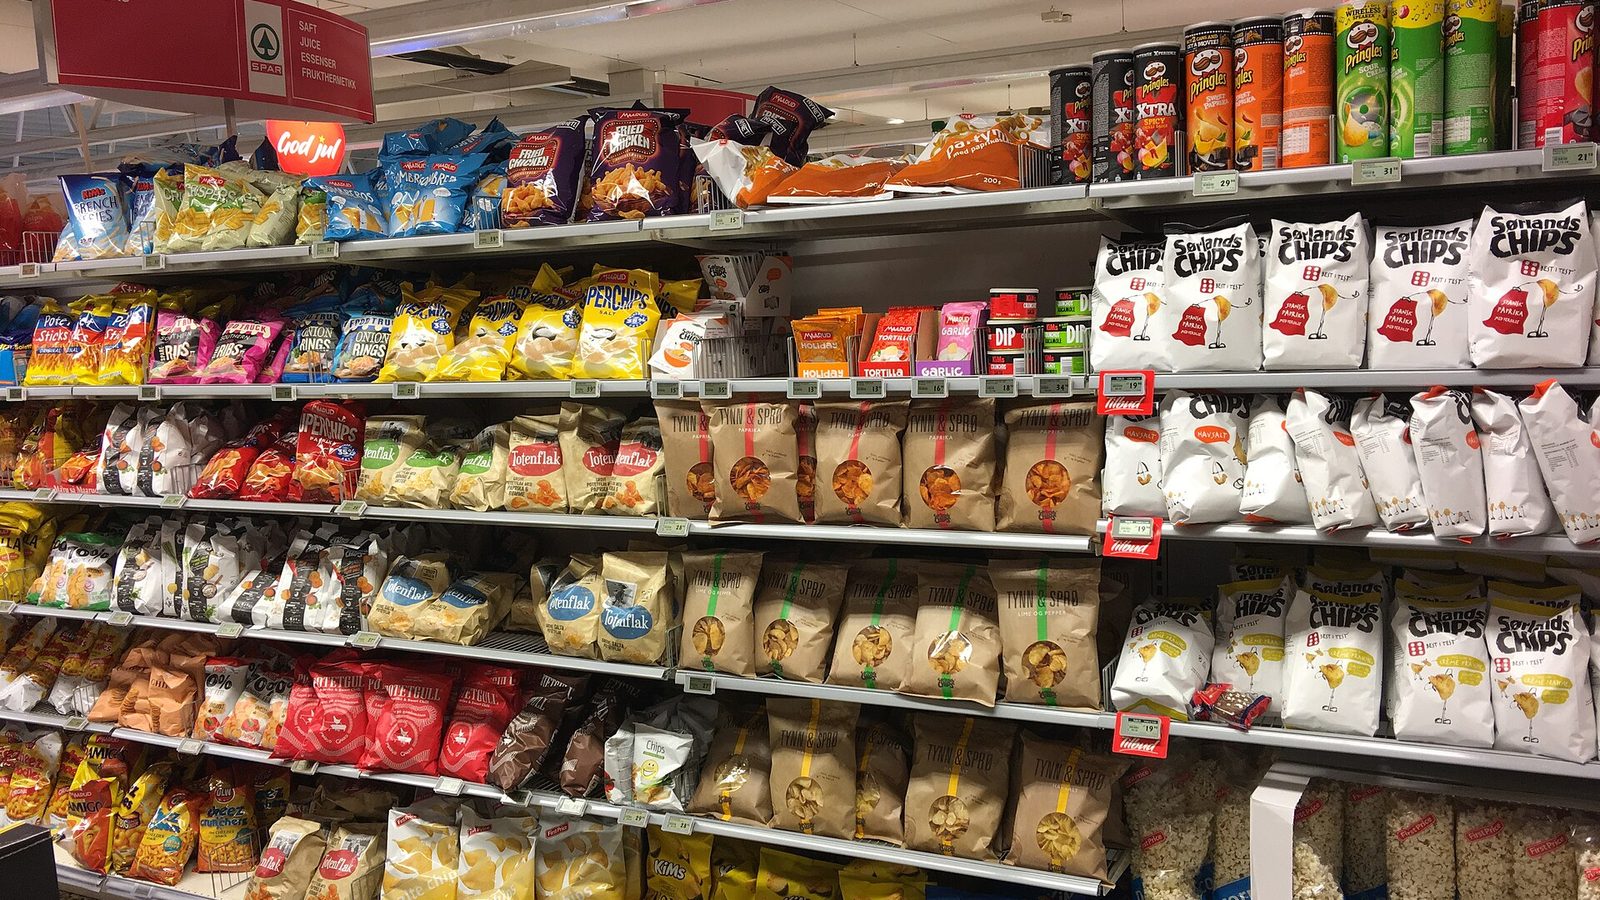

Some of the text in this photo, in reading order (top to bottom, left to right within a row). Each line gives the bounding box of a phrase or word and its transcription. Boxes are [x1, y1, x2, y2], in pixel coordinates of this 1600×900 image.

[1345, 6, 1381, 18] WIRELESS
[299, 20, 318, 35] SAFT
[299, 35, 321, 50] JUICE
[301, 52, 337, 70] ESSENSER
[1345, 44, 1383, 75] Pringles
[252, 63, 282, 75] SPAR
[1358, 63, 1380, 75] SOUR
[301, 67, 357, 91] FRUKTHERMETIKK
[1142, 77, 1169, 98] Pringles
[1190, 72, 1227, 103] Pringles
[620, 111, 650, 119] MAARUD
[1136, 103, 1177, 119] XTRA
[616, 123, 644, 136] FRIED
[277, 131, 341, 164] God jul
[518, 146, 545, 159] FRIED
[953, 147, 969, 159] med
[508, 156, 549, 170] CHICKEN
[1490, 216, 1581, 234] Sørlands
[1278, 225, 1355, 244] Sørlands
[1384, 227, 1469, 244] Sørlands
[1173, 233, 1243, 255] Sørlands
[1490, 230, 1582, 258] CHIPS
[1277, 240, 1357, 266] CHIPS
[1383, 240, 1469, 269] CHIPS
[1173, 249, 1244, 278] CHIPS
[1541, 265, 1554, 273] BEST
[1321, 270, 1334, 279] BEST
[1110, 311, 1132, 323] PAPRIKA
[1281, 309, 1306, 320] PAPRIKA
[1497, 306, 1524, 317] PAPRIKA
[239, 323, 267, 333] TRUCK
[884, 325, 913, 333] MAARUD
[1182, 319, 1204, 331] PAPRIKA
[1388, 315, 1414, 326] PAPRIKA
[37, 330, 68, 342] Sticks
[300, 326, 334, 338] ONION
[354, 330, 391, 343] ONION
[803, 331, 832, 340] MAARUD
[995, 327, 1016, 347] DIP
[300, 338, 332, 352] RINGS
[351, 342, 386, 357] RINGS
[1128, 381, 1138, 389] 19
[671, 415, 697, 433] TYNN
[719, 407, 783, 425] TYNN & SPRØ
[830, 411, 855, 430] TYNN
[910, 414, 978, 434] TYNN & SPRØ
[1019, 408, 1092, 427] TYNN & SPRØ
[1126, 427, 1157, 440] HAVSALT
[1197, 431, 1228, 440] HAVSALT
[511, 450, 561, 467] Totenflak
[1136, 525, 1146, 533] 19
[721, 572, 742, 589] SPRØ
[928, 586, 954, 603] TYNN
[1006, 590, 1079, 609] TYNN & SPRØ
[1309, 606, 1380, 634] CHIPS
[1408, 615, 1487, 639] CHIPS
[1496, 631, 1573, 656] CHIPS
[1145, 725, 1154, 733] 19
[645, 739, 666, 754] Chips
[780, 730, 839, 748] TYNN & SPRØ
[927, 743, 993, 771] TYNN & SPRØ
[1035, 758, 1105, 791] TYNN & SPRØ
[1400, 816, 1433, 838] First Price
[1468, 823, 1502, 840] First Price
[1529, 836, 1566, 855] First Price
[653, 859, 687, 880] KiMs
